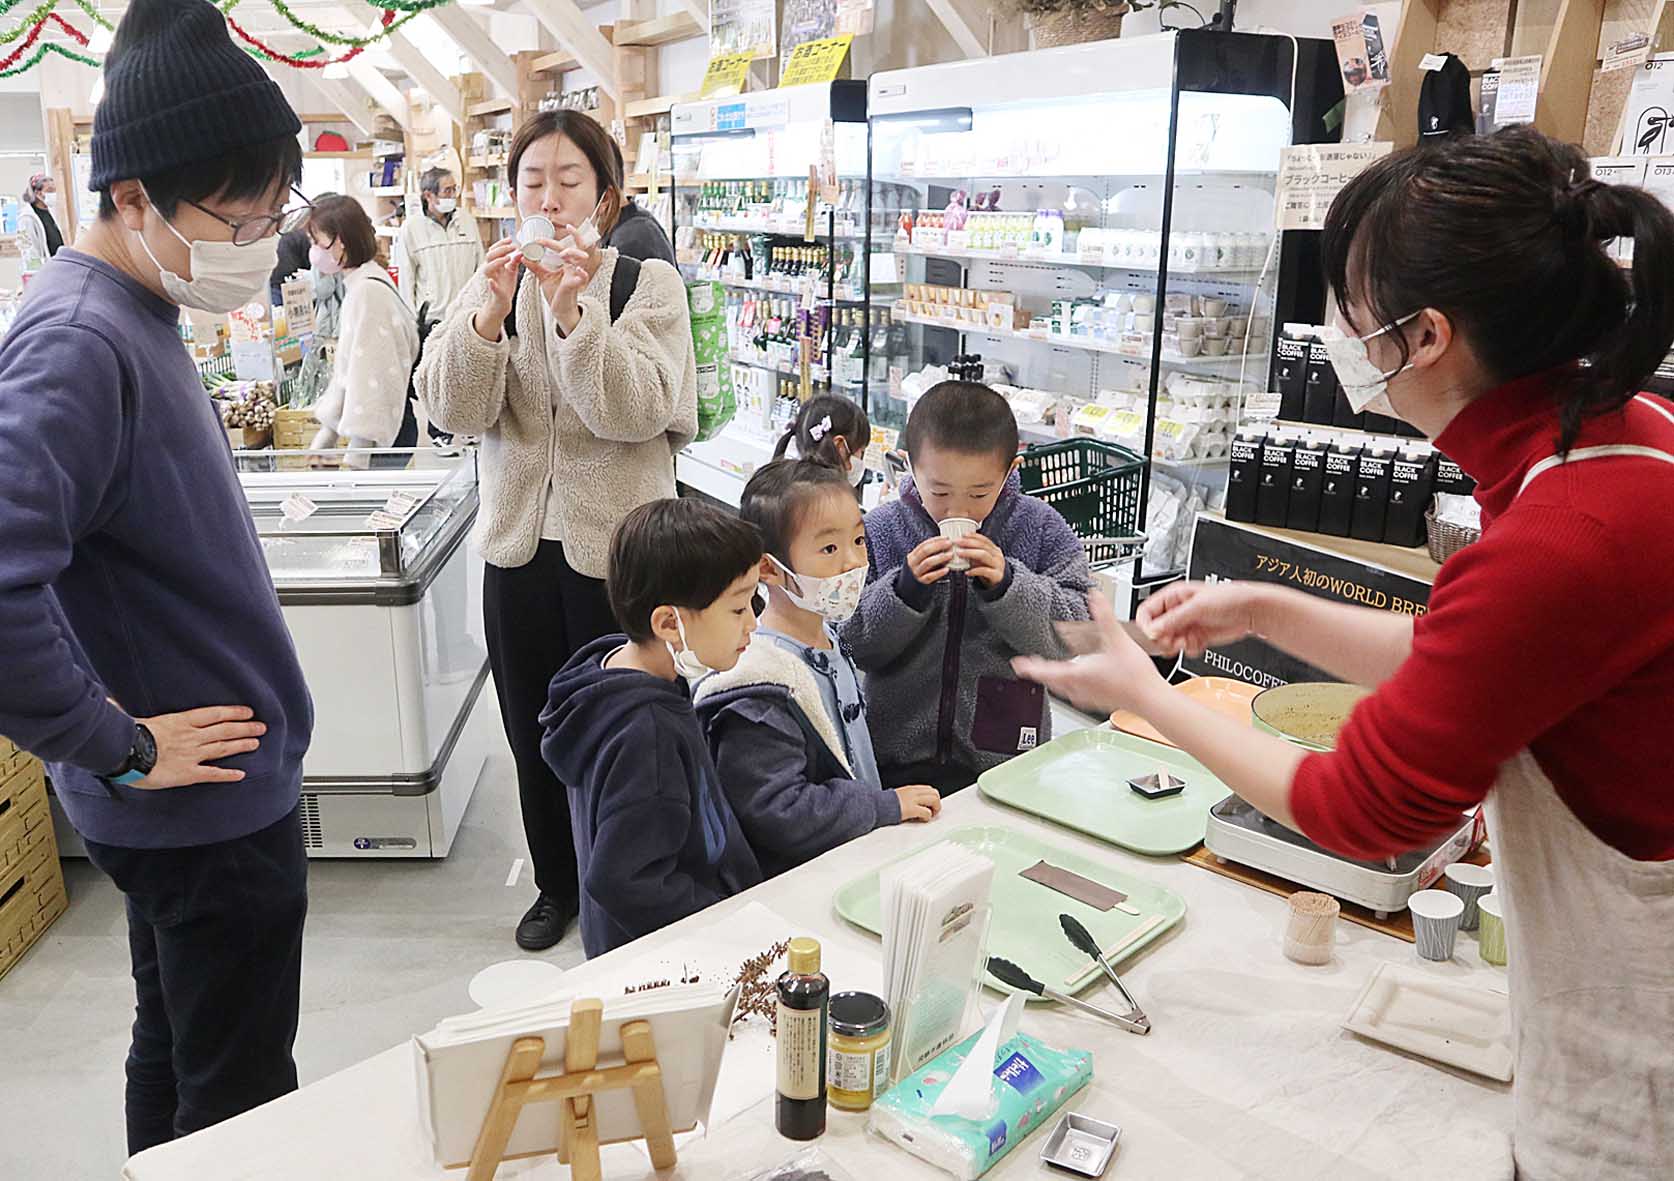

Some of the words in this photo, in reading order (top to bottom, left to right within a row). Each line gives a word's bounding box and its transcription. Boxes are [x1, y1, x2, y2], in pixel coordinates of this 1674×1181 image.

[1281, 350, 1303, 358] COFFEE
[1231, 452, 1254, 460] COFFEE
[1264, 449, 1284, 457] BLACK
[1295, 453, 1316, 461] BLACK
[1263, 455, 1287, 464] COFFEE
[1294, 459, 1318, 468] COFFEE
[1327, 456, 1348, 465] BLACK
[1326, 463, 1350, 472] COFFEE
[1360, 460, 1382, 469] BLACK
[1394, 465, 1416, 473] BLACK
[1439, 465, 1461, 473] BLACK
[1359, 467, 1384, 476] COFFEE
[1393, 471, 1418, 480] COFFEE
[1438, 471, 1463, 480] COFFEE
[1022, 733, 1035, 745] Lee
